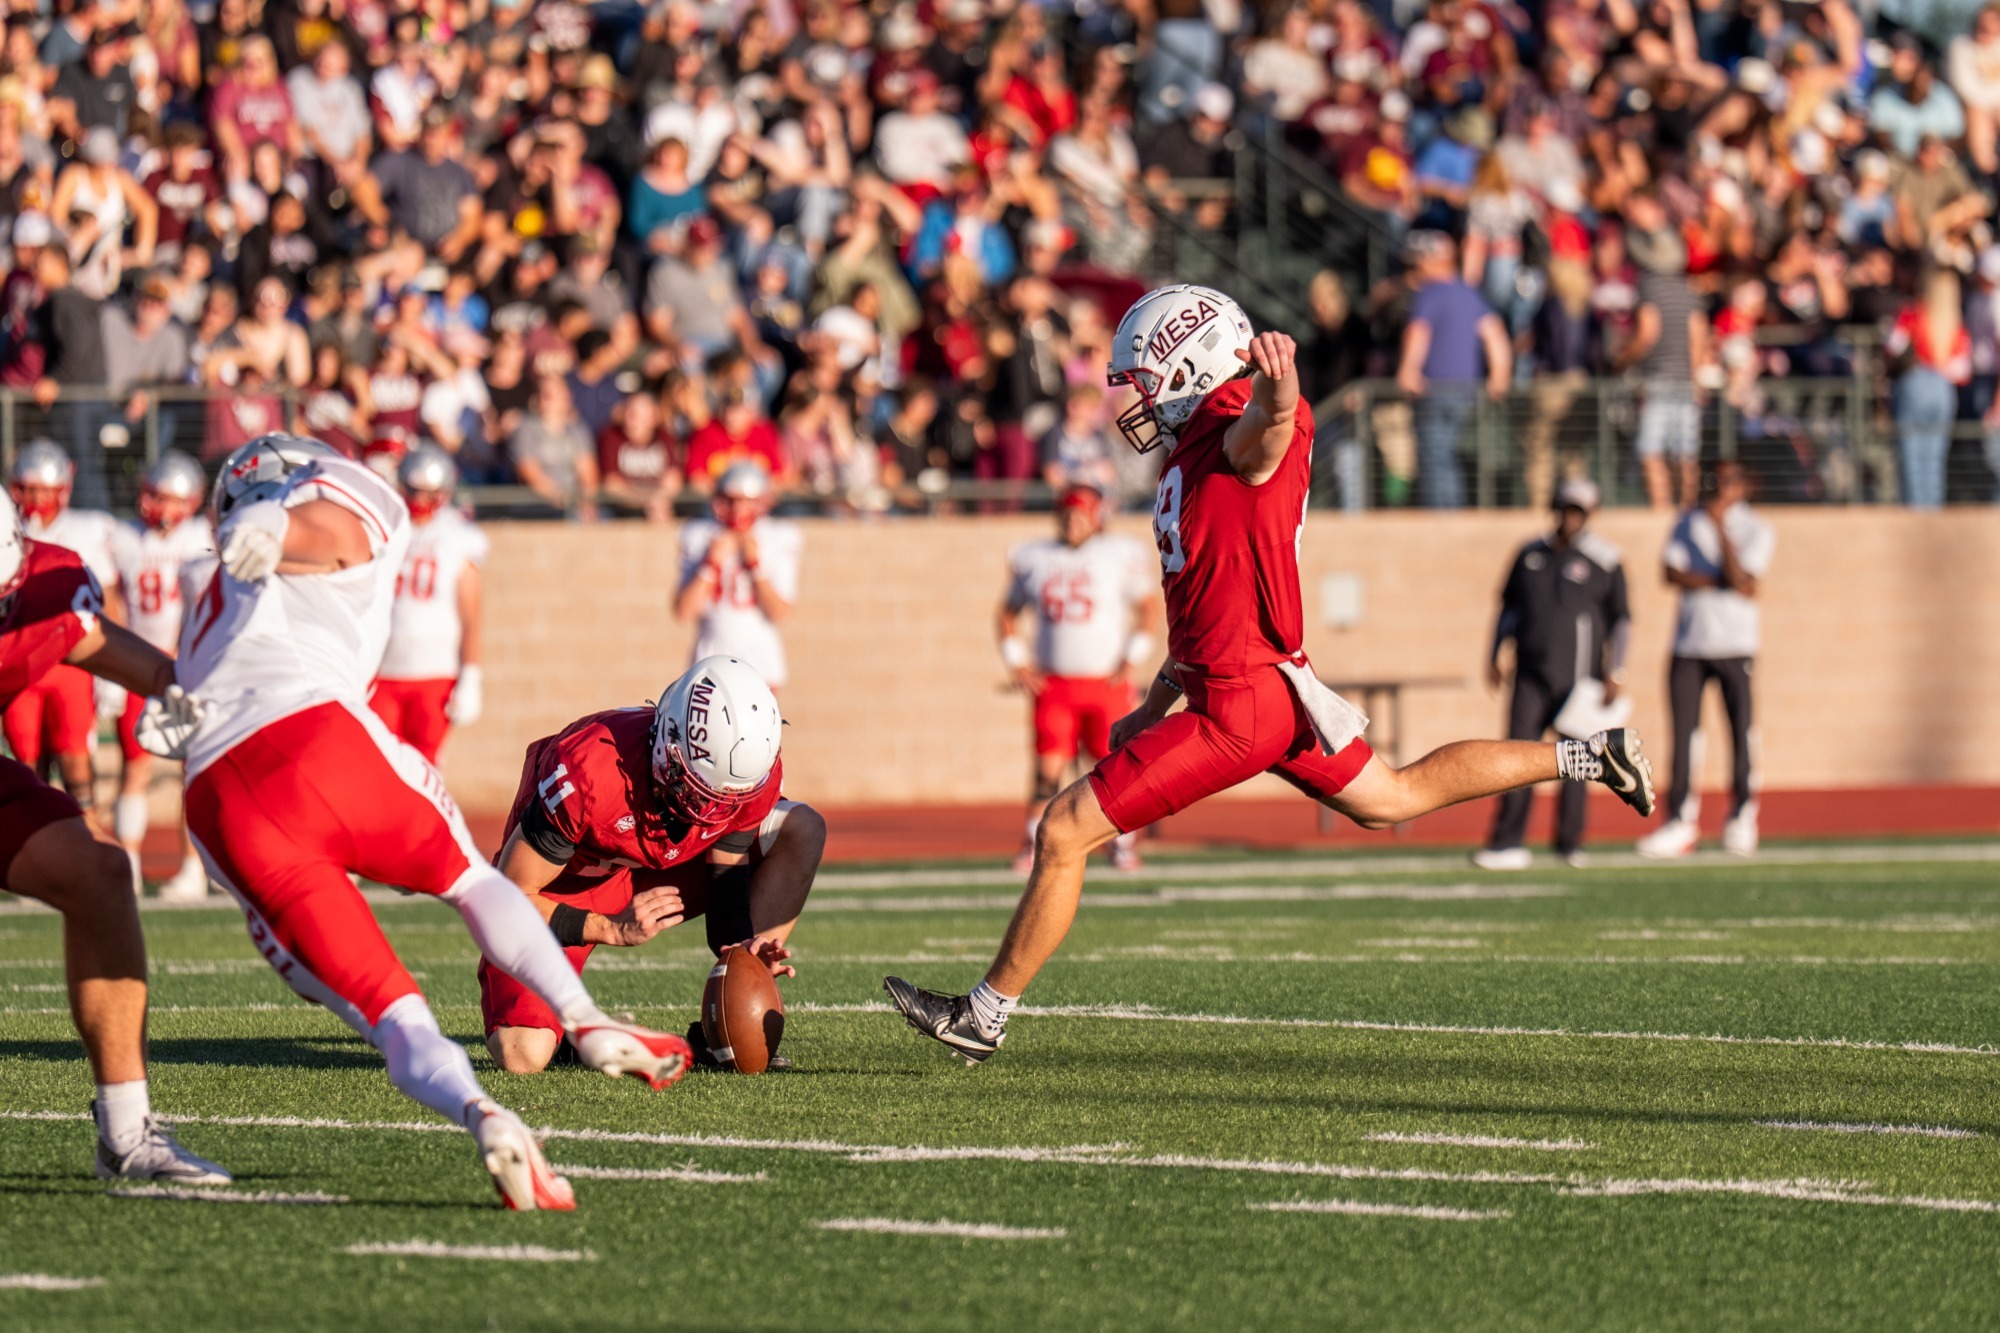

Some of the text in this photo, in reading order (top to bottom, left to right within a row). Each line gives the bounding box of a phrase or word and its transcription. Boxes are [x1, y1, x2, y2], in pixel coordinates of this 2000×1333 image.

[1149, 300, 1217, 361] MESA
[1041, 573, 1094, 625] 65
[689, 684, 713, 761] MESA
[538, 763, 576, 815] 11
